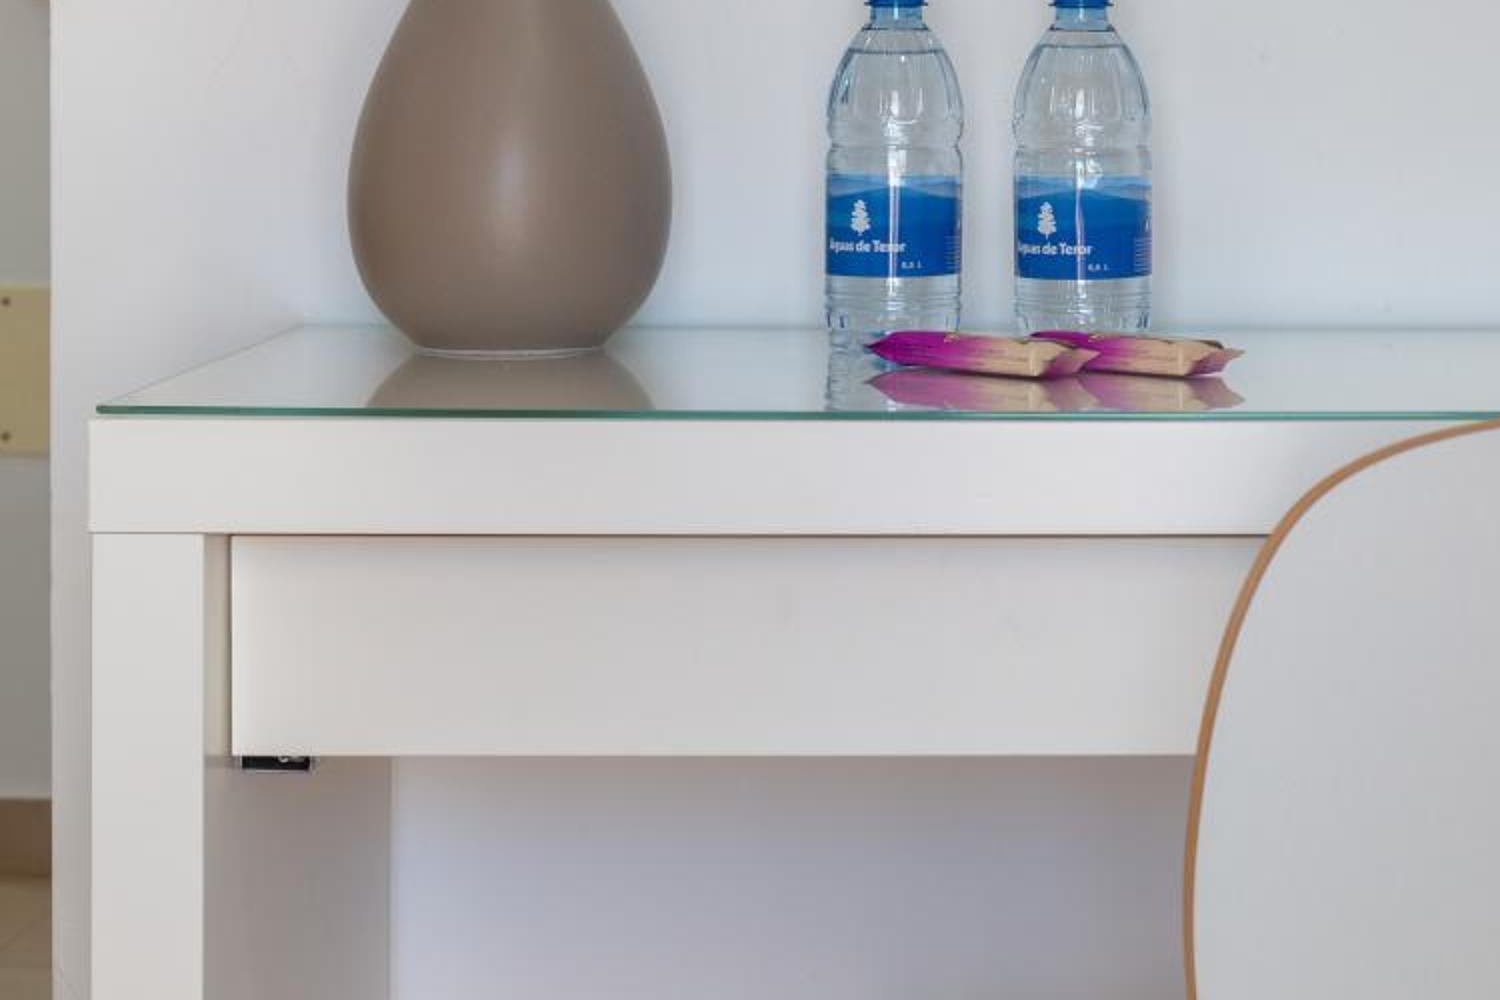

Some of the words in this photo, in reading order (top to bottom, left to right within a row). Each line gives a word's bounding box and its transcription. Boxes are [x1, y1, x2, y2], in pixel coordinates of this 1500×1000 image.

[855, 239, 871, 253] de
[872, 239, 907, 253] Teror
[1041, 241, 1057, 255] de
[1059, 241, 1094, 255] Teror
